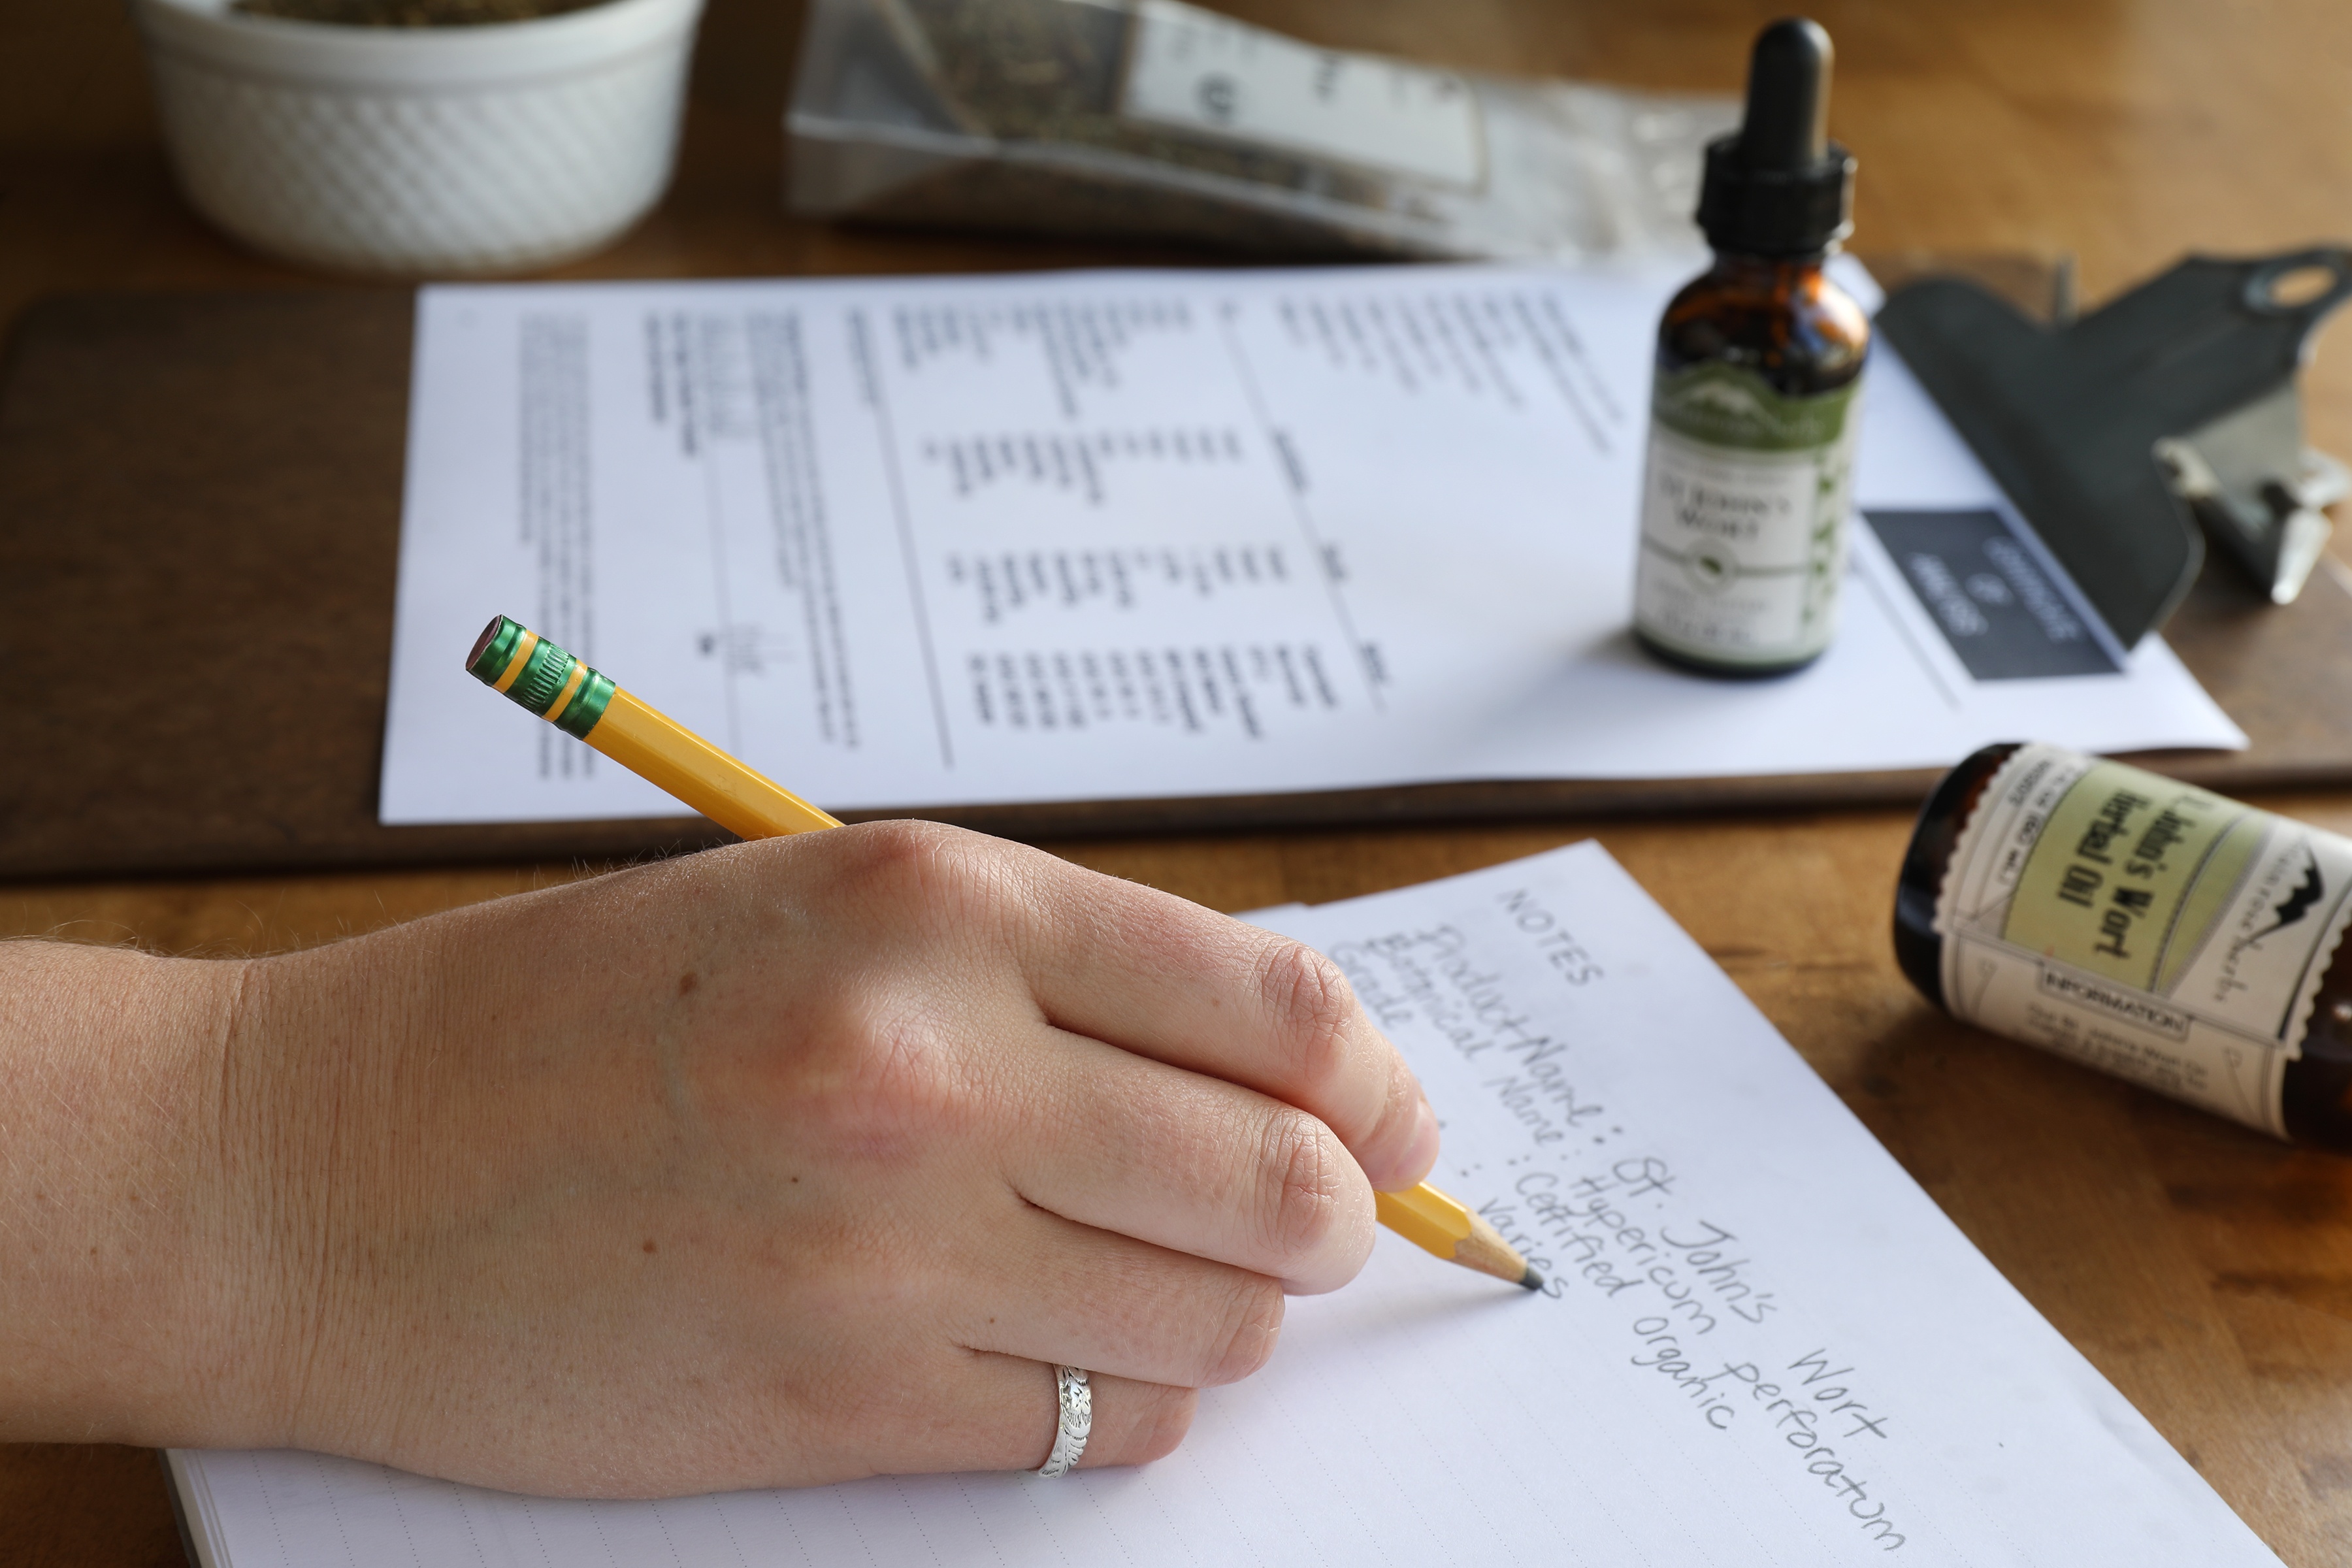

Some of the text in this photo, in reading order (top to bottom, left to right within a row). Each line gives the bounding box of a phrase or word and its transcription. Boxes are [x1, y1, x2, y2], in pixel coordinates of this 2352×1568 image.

[2074, 785, 2153, 866] Herbal
[2056, 864, 2105, 910] Oil
[2095, 885, 2155, 961] Wort
[1497, 889, 1605, 987] NOTES
[2044, 970, 2187, 1034] INFORMATION
[1328, 941, 1413, 1029] Grade
[1514, 1172, 1644, 1298] Certified
[1416, 924, 1535, 1043] Product
[1613, 1156, 1676, 1209] St.
[1659, 1220, 1777, 1325] John's
[1787, 1348, 1888, 1439] Wort
[1364, 934, 1495, 1061] Botanical
[1568, 1174, 1716, 1335] Hypericum
[1701, 1363, 1906, 1552] perforatum
